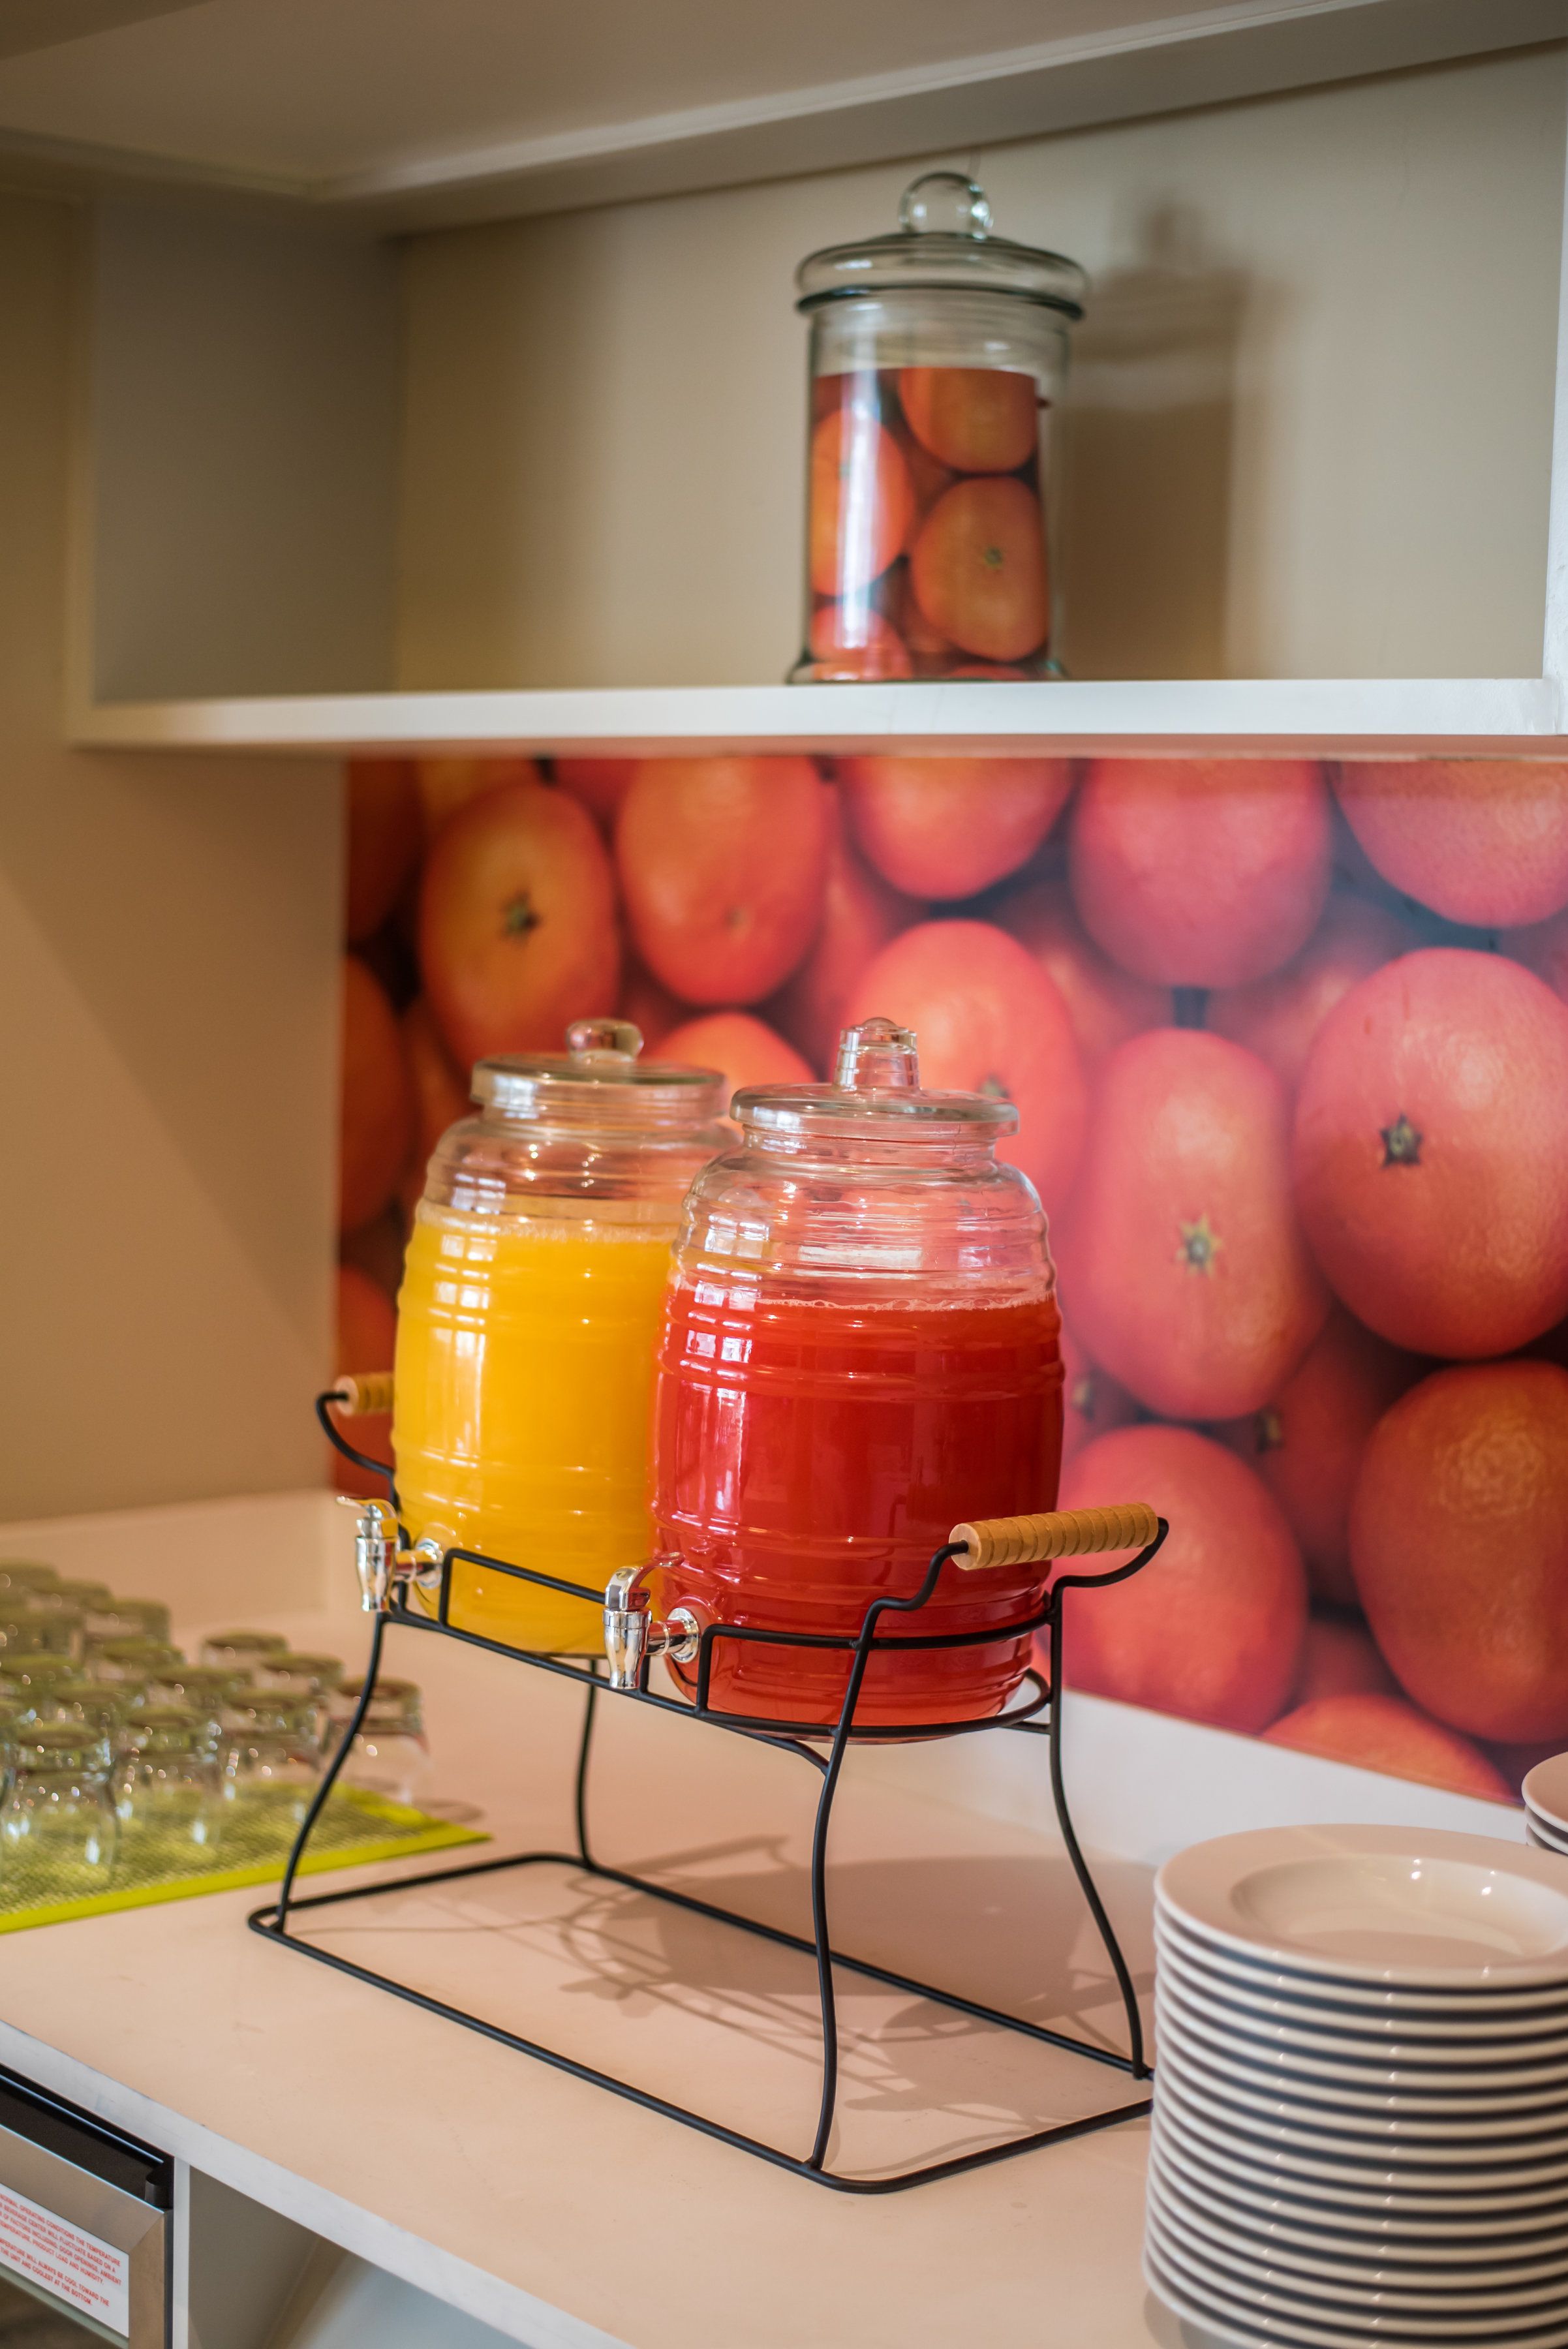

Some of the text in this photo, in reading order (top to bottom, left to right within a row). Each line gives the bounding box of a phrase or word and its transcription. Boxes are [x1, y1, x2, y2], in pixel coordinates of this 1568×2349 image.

[4, 2205, 27, 2222] BEVERAGE
[29, 2218, 46, 2232] CENTER
[48, 2230, 59, 2240] WILL
[59, 2236, 85, 2256] FLUCTUATE
[87, 2252, 102, 2265] BASED
[10, 2218, 31, 2233] FACTORS
[59, 2246, 73, 2257] DOOR
[100, 2270, 121, 2286] AMBIENT
[20, 2205, 45, 2223] OPERATING
[46, 2220, 74, 2240] CONDITIONS
[86, 2242, 121, 2266] TEMPERATURE
[33, 2239, 54, 2256] PRODUCT
[55, 2252, 69, 2264] LOAD
[70, 2261, 79, 2271] AND
[10, 2253, 20, 2262] UNIT
[22, 2261, 31, 2269] AND
[33, 2265, 53, 2282] COOLEST
[26, 2254, 37, 2264] WILL
[38, 2260, 56, 2276] ALWAYS
[65, 2276, 78, 2288] COOL
[79, 2284, 99, 2300] TOWARD
[100, 2296, 110, 2307] THE
